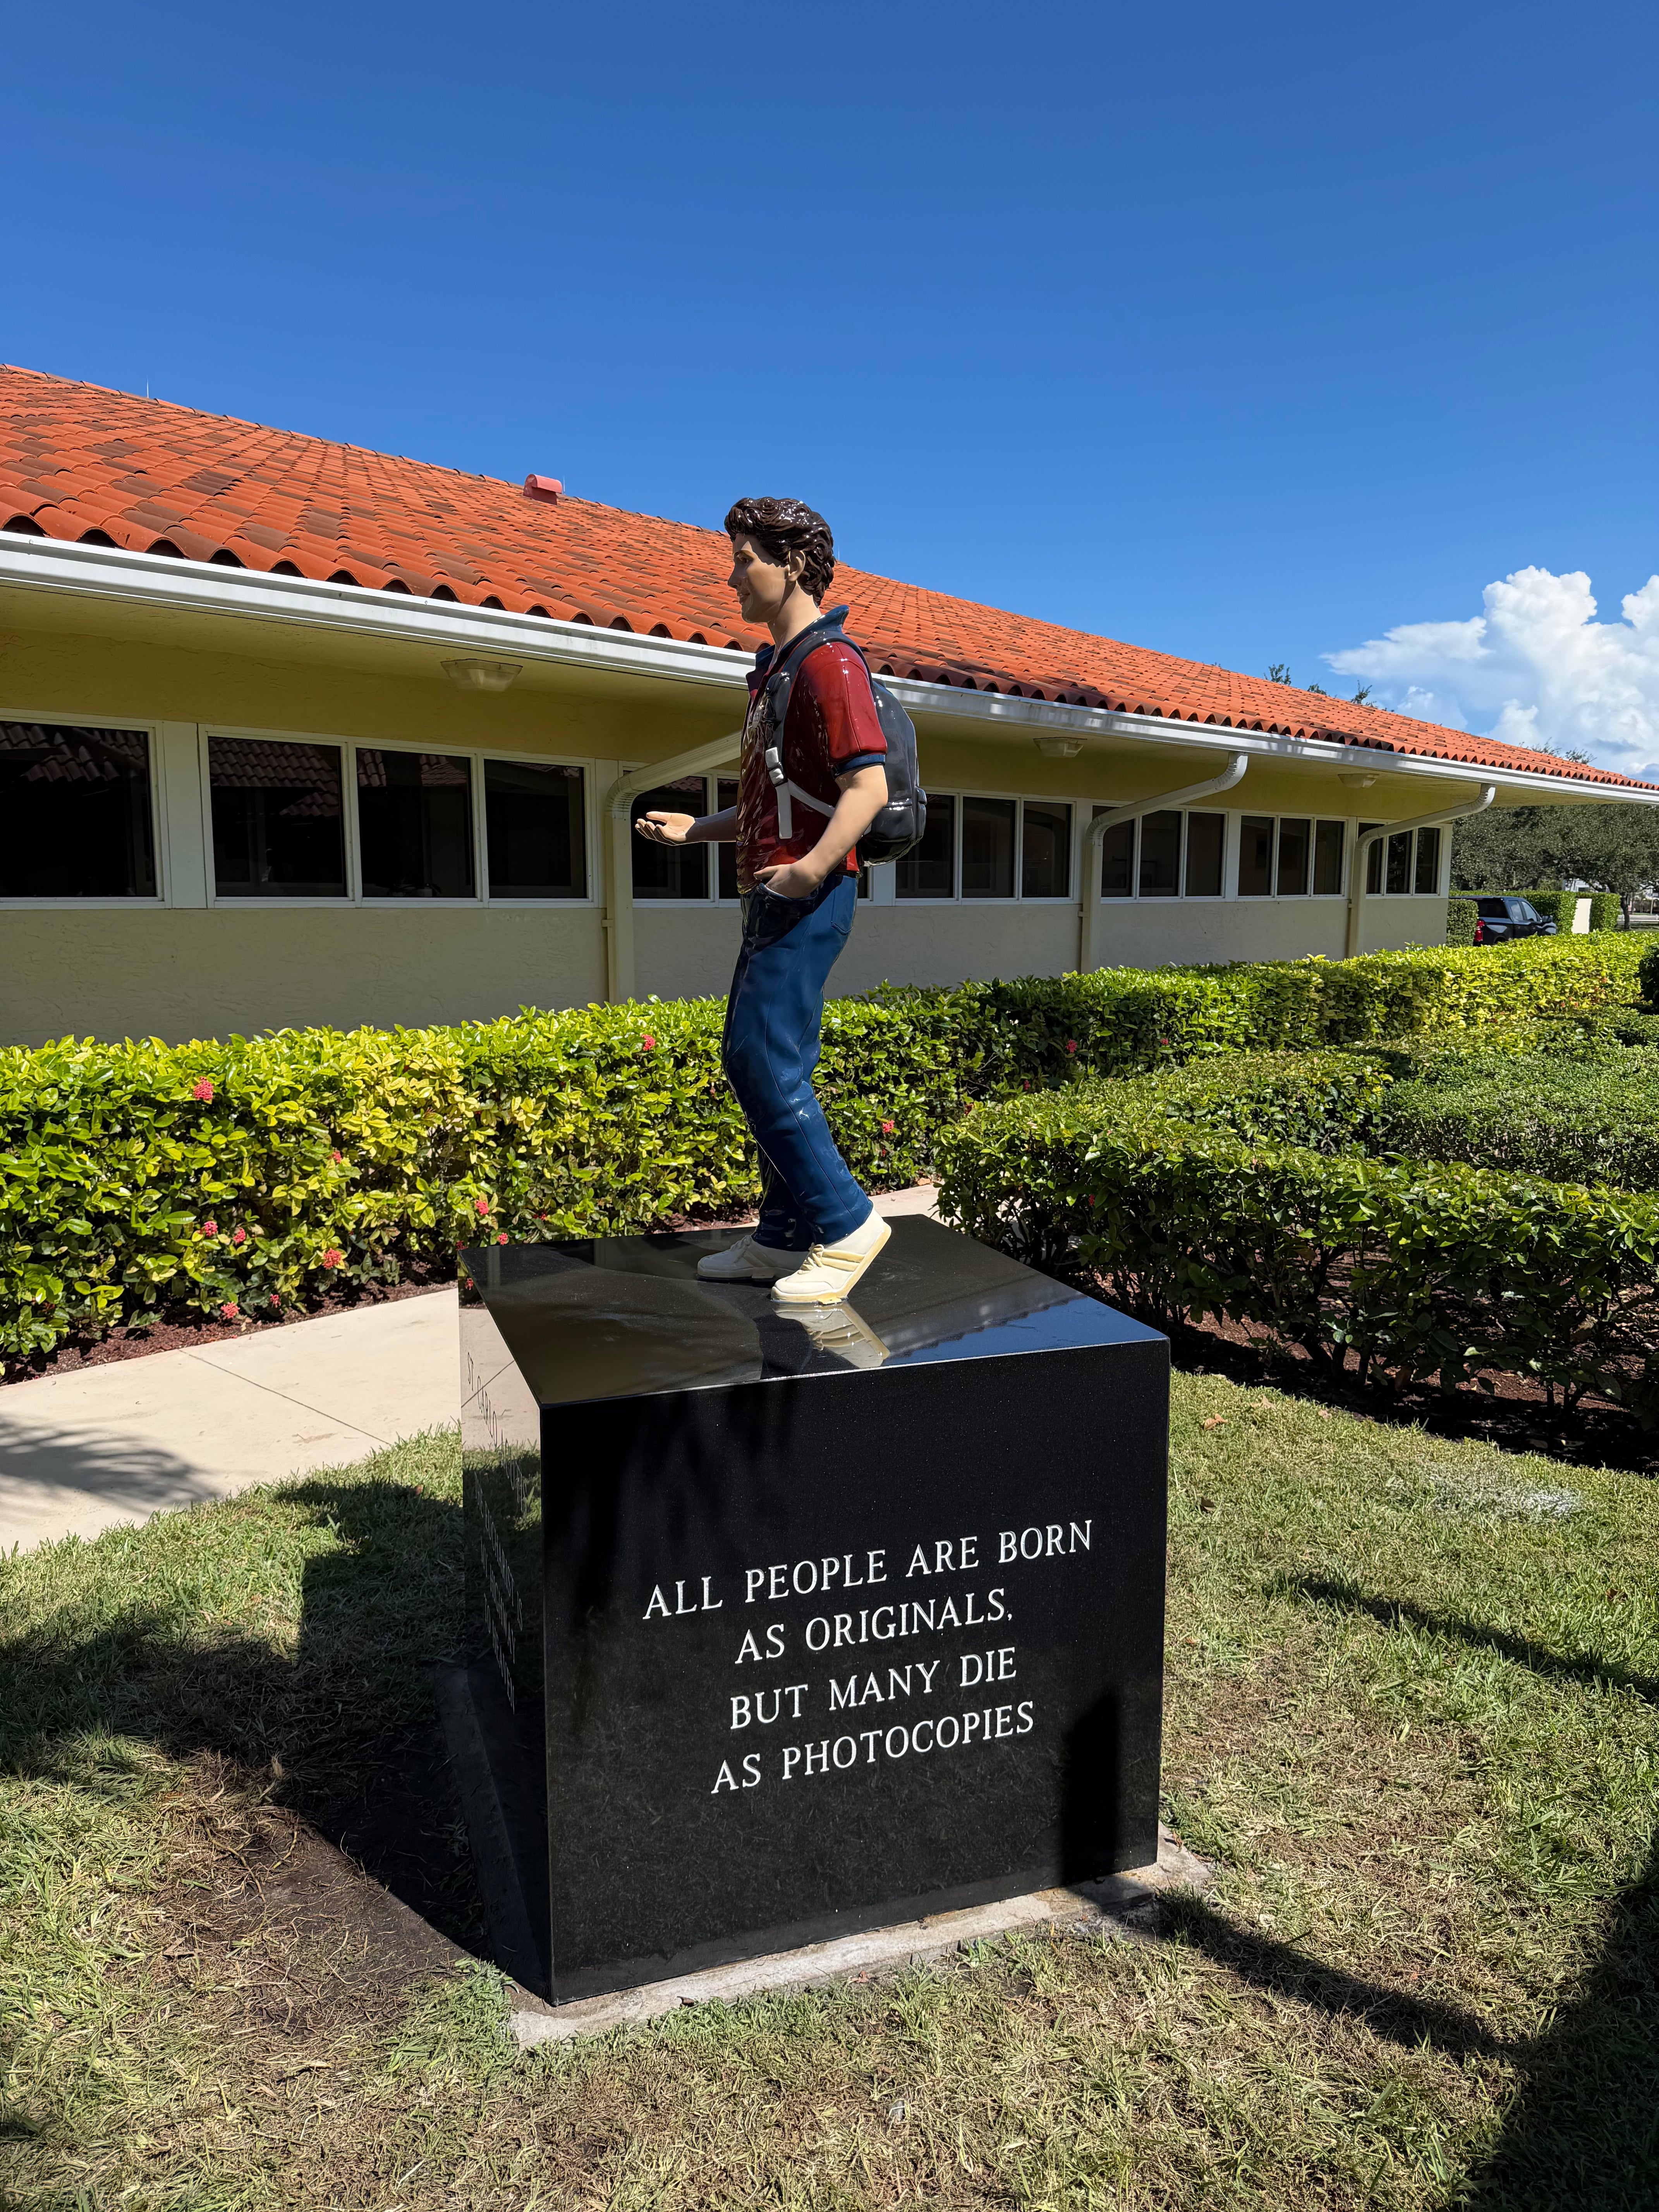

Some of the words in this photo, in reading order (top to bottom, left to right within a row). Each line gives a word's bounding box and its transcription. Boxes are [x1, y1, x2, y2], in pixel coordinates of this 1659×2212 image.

[467, 1351, 474, 1391] ST
[477, 1375, 497, 1448] CARLO
[474, 1471, 484, 1518] THE
[484, 1500, 515, 1607] EUCHARIST
[517, 1590, 522, 1632] IS
[480, 1536, 488, 1578] MY
[489, 1563, 516, 1664] HIGHWAY
[642, 1576, 723, 1620] ALL
[744, 1549, 888, 1604] PEOPLE
[905, 1535, 979, 1578] ARE
[998, 1519, 1092, 1563] BORN
[483, 1593, 491, 1633] TO
[492, 1619, 515, 1715] HEAVEN
[734, 1623, 785, 1664] AS
[805, 1587, 1013, 1651] ORIGINALS,
[730, 1683, 809, 1730] BUT
[828, 1659, 941, 1711] MANY
[959, 1646, 1017, 1687] DIE
[710, 1753, 761, 1794] AS
[781, 1700, 1034, 1780] PHOTOCOPIES
